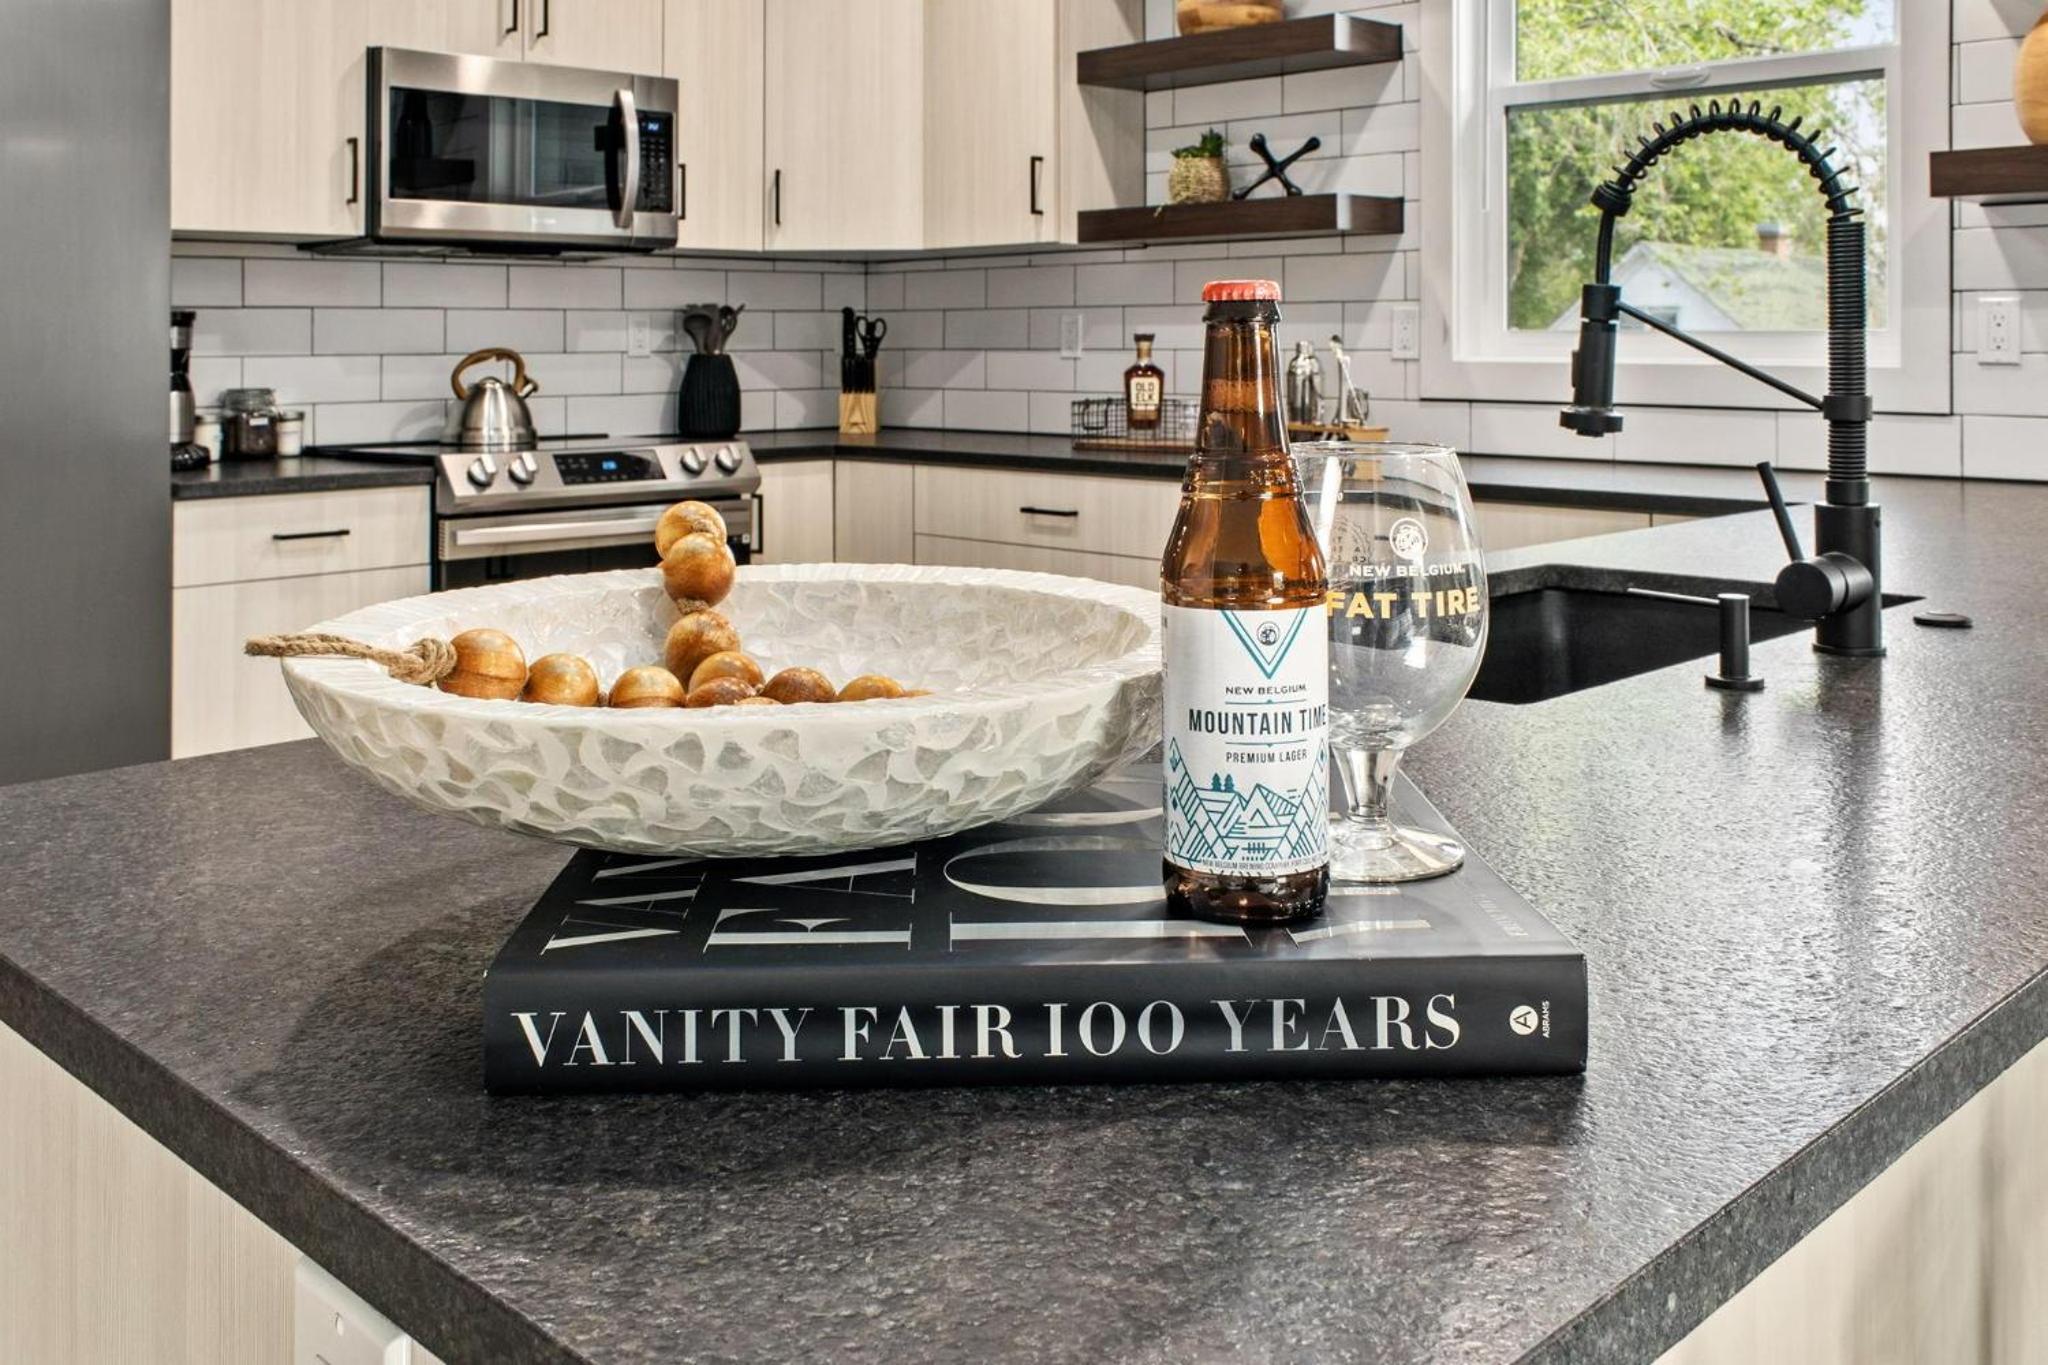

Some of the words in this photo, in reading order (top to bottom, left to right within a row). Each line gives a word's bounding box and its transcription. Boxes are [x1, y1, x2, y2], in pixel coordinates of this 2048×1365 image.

[1350, 565, 1391, 577] NEW
[1326, 591, 1398, 619] FAT
[1411, 587, 1481, 619] TIRE
[1225, 686, 1254, 695] NEW
[1258, 684, 1307, 695] BELGIUM
[1189, 708, 1292, 735] MOUNTAIN
[1226, 751, 1275, 763] PREMIUM
[1280, 749, 1308, 762] LAGER
[510, 1008, 815, 1068] VANITY
[837, 1004, 1023, 1061] FAIR
[1210, 993, 1461, 1052] YEARS
[1542, 1000, 1550, 1039] ABRAMS
